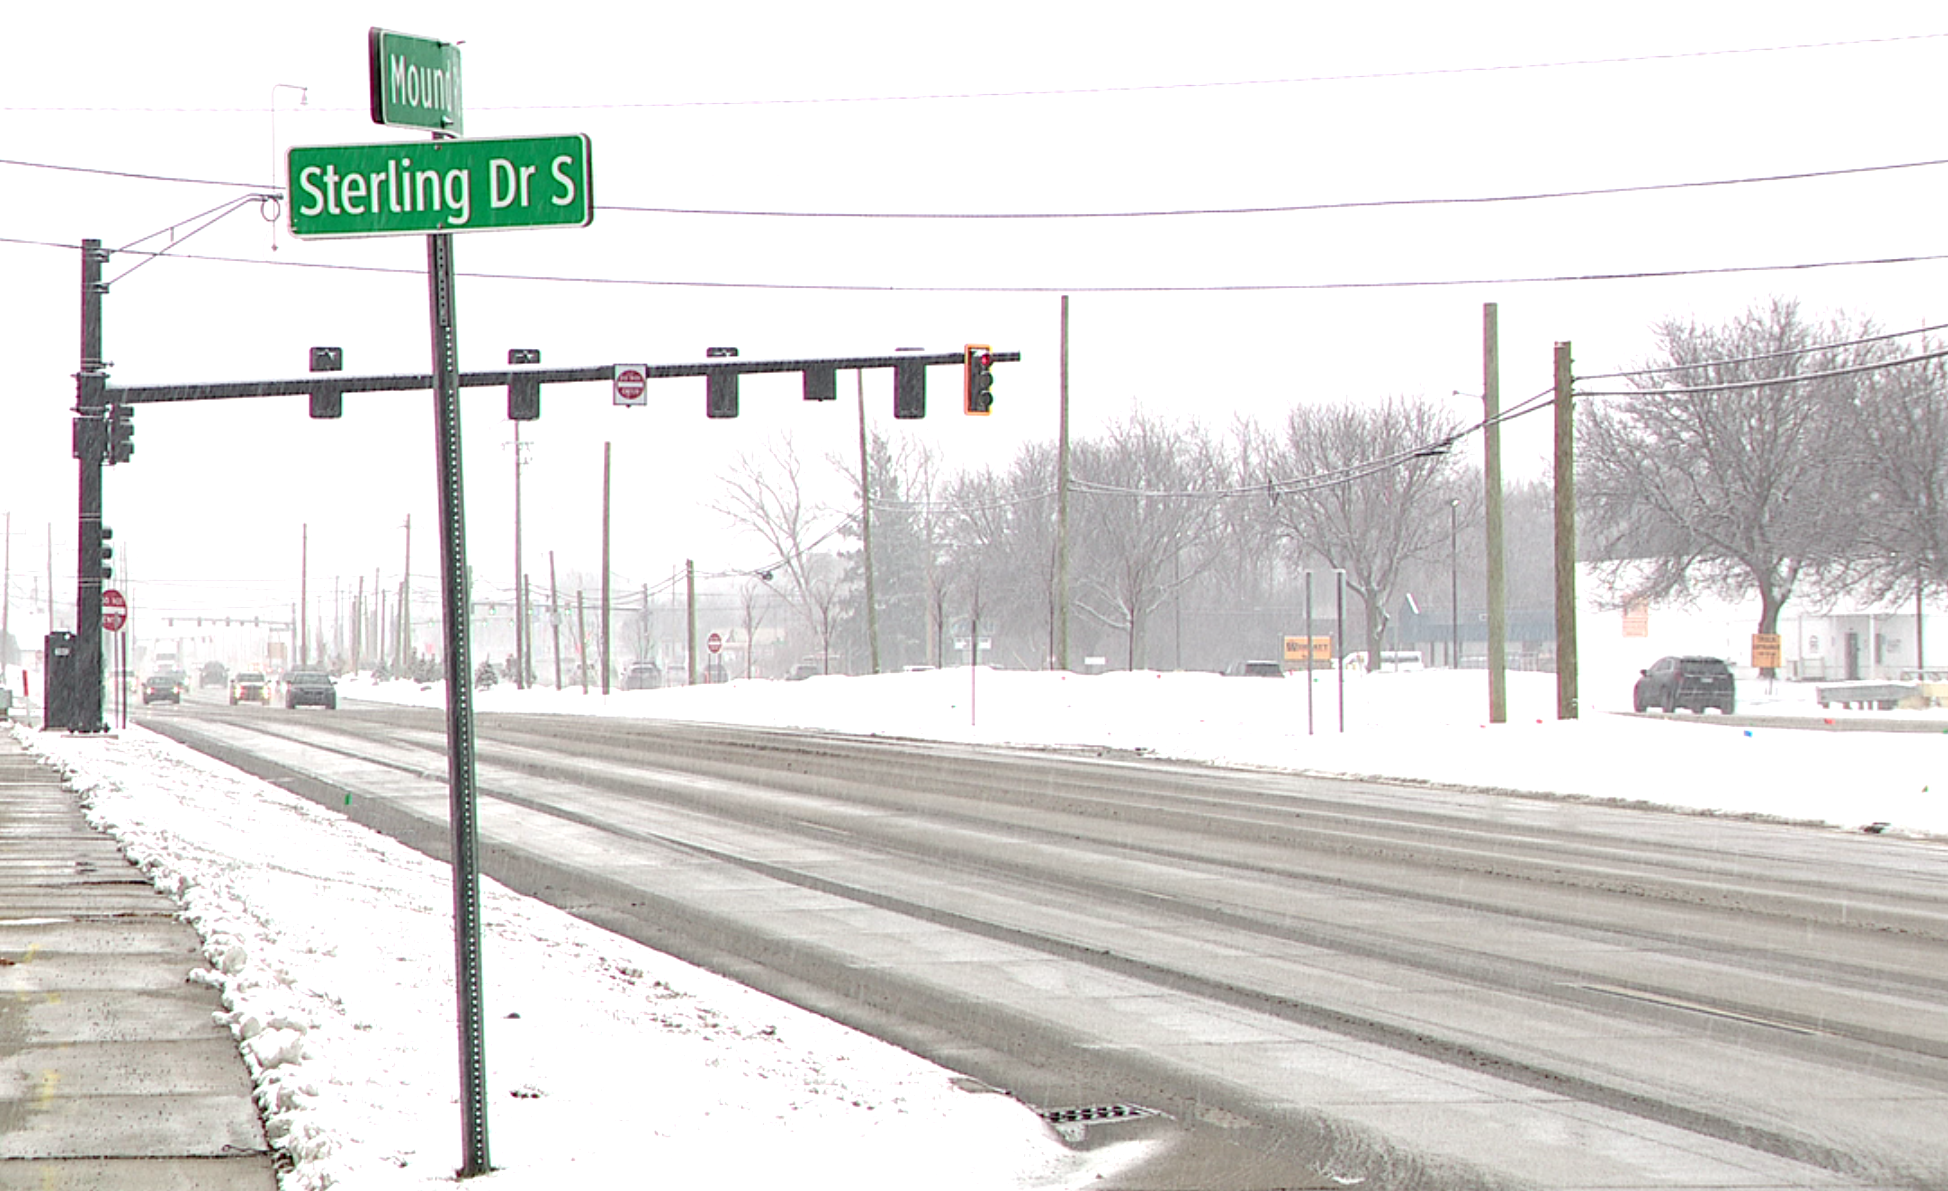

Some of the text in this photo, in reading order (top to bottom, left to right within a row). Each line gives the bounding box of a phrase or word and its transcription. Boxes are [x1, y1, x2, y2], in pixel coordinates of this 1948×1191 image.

[391, 53, 452, 112] Mound
[299, 155, 576, 225] Sterling Dr S
